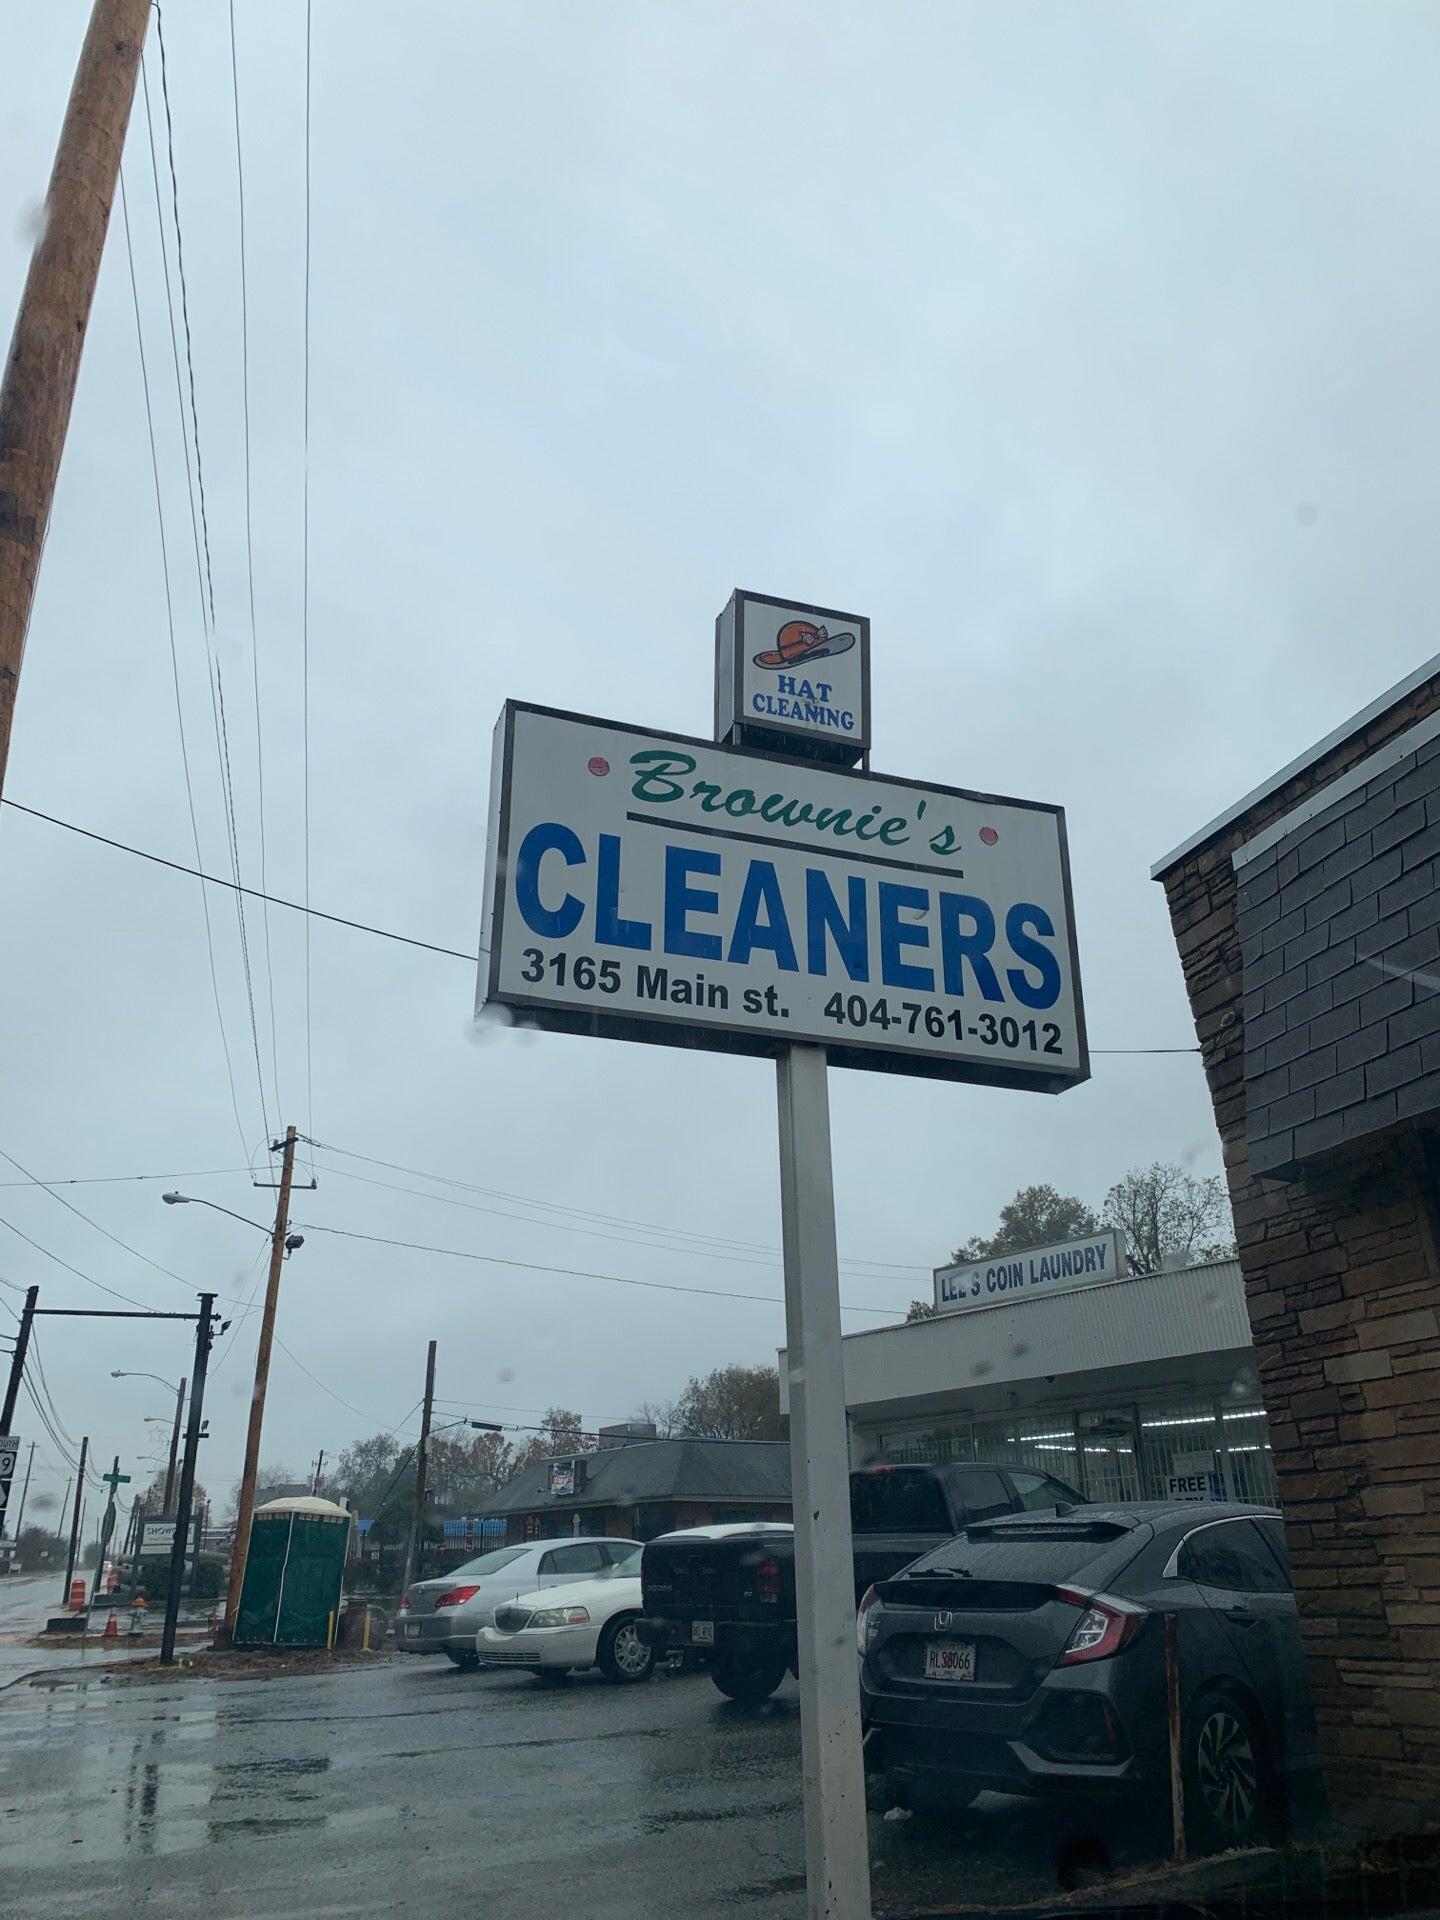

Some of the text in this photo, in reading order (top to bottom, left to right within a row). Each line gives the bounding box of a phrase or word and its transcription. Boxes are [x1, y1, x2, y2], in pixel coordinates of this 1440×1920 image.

[752, 692, 855, 731] CLEANING
[778, 674, 832, 703] HAT
[629, 749, 962, 856] Brownie's
[515, 822, 1062, 1010] CLEANERS
[521, 947, 1063, 1055] 3165 Main st. 404-761-3012
[941, 1243, 1107, 1303] LES COIN LAUNDRY
[0, 1439, 18, 1449] OUTH
[1169, 1475, 1207, 1494] FREE
